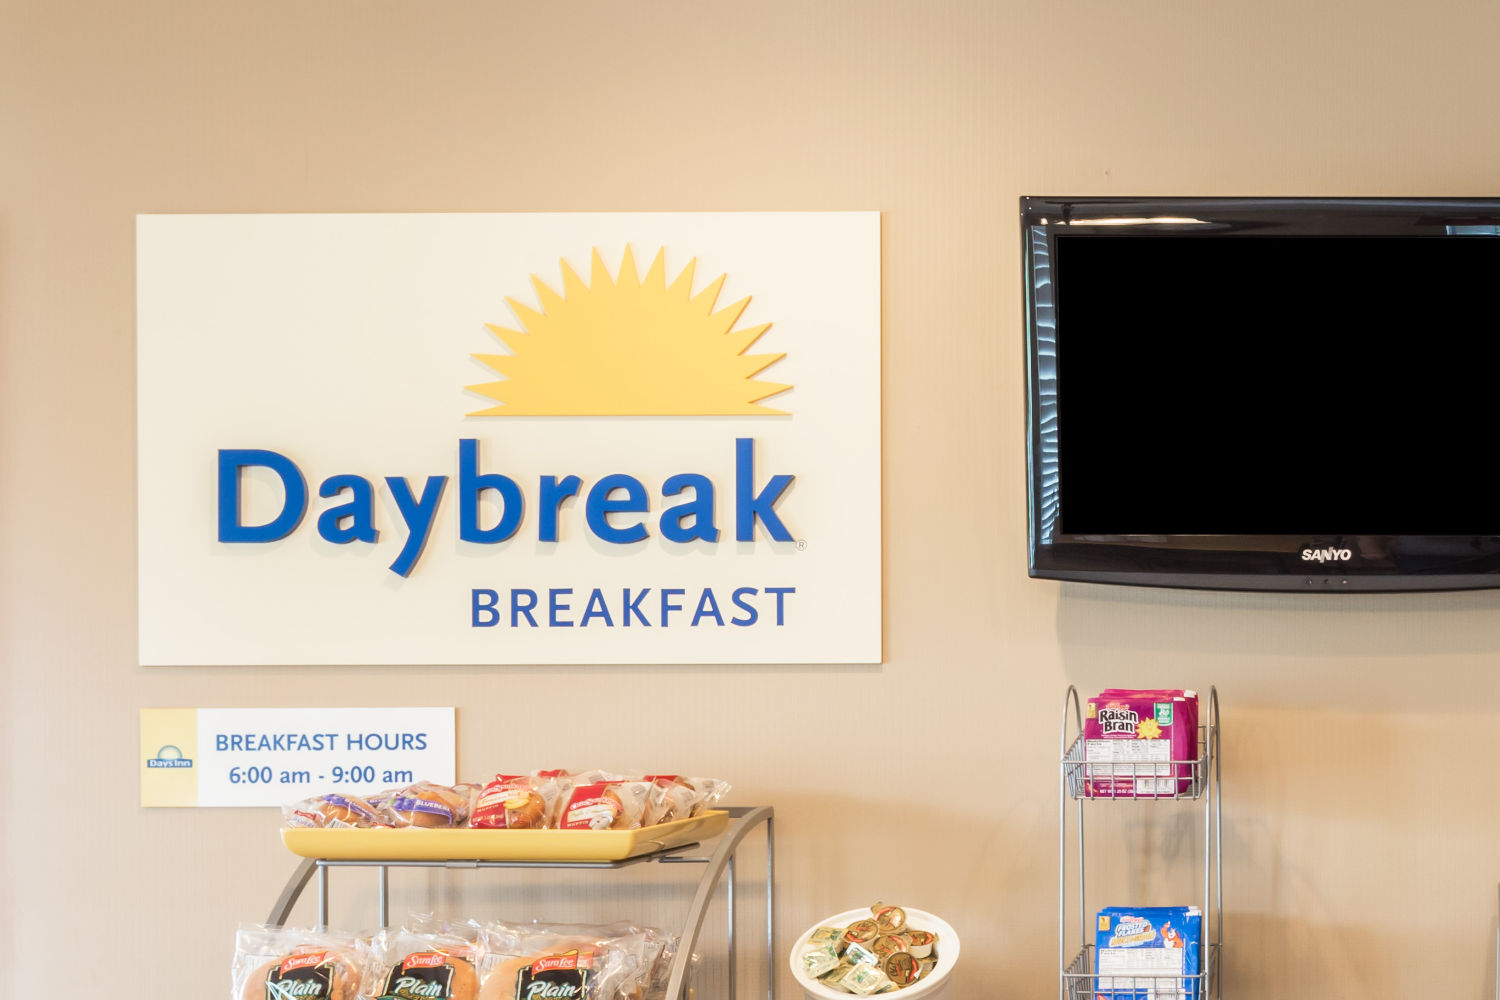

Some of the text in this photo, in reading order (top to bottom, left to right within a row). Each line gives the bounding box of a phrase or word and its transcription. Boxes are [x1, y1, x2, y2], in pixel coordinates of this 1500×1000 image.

[217, 438, 796, 578] Daybreak
[1301, 546, 1352, 563] SANYO
[472, 588, 796, 627] BREAKFAST
[1099, 710, 1137, 723] Raisin
[1104, 721, 1134, 733] Bran
[216, 733, 427, 751] BREAKFAST HOURS
[229, 766, 272, 783] 6:00
[280, 769, 311, 783] am
[332, 766, 375, 783] 9:00
[382, 769, 413, 783] am
[278, 976, 322, 996] Plain
[396, 976, 443, 997] Plain
[527, 980, 576, 1000] Plain
